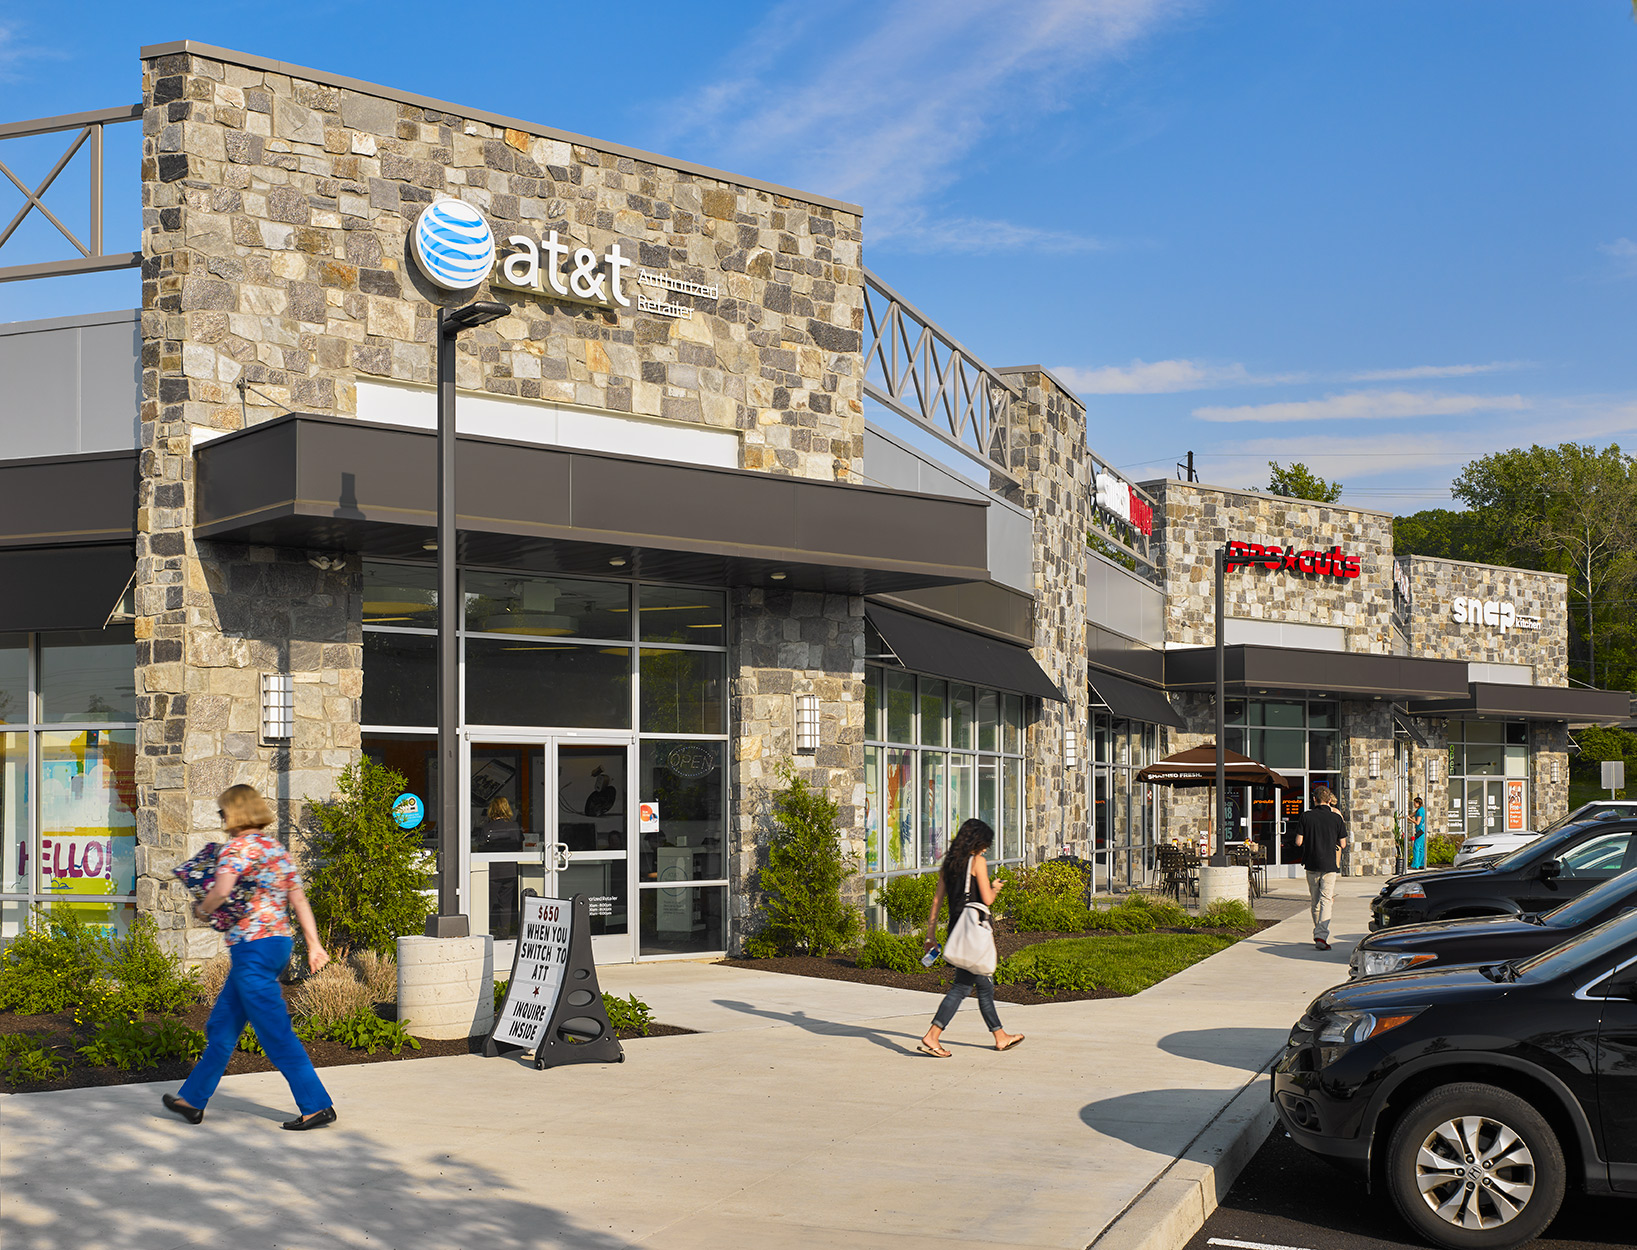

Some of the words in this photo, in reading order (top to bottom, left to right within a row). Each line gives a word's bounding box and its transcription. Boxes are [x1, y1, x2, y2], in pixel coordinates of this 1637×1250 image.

[504, 230, 630, 306] at&t
[637, 268, 719, 300] Authorized
[637, 294, 696, 320] Retailer
[1453, 597, 1516, 634] snap
[1515, 618, 1541, 630] kitchen
[670, 753, 714, 770] OPEN
[538, 905, 560, 923] $650
[527, 923, 550, 942] WHEN
[552, 926, 568, 944] YOU
[521, 942, 552, 962] SWITCH
[556, 947, 567, 964] TO
[531, 964, 549, 981] ATT
[513, 1001, 547, 1021] INQUIRE
[508, 1020, 538, 1041] INSIDE
